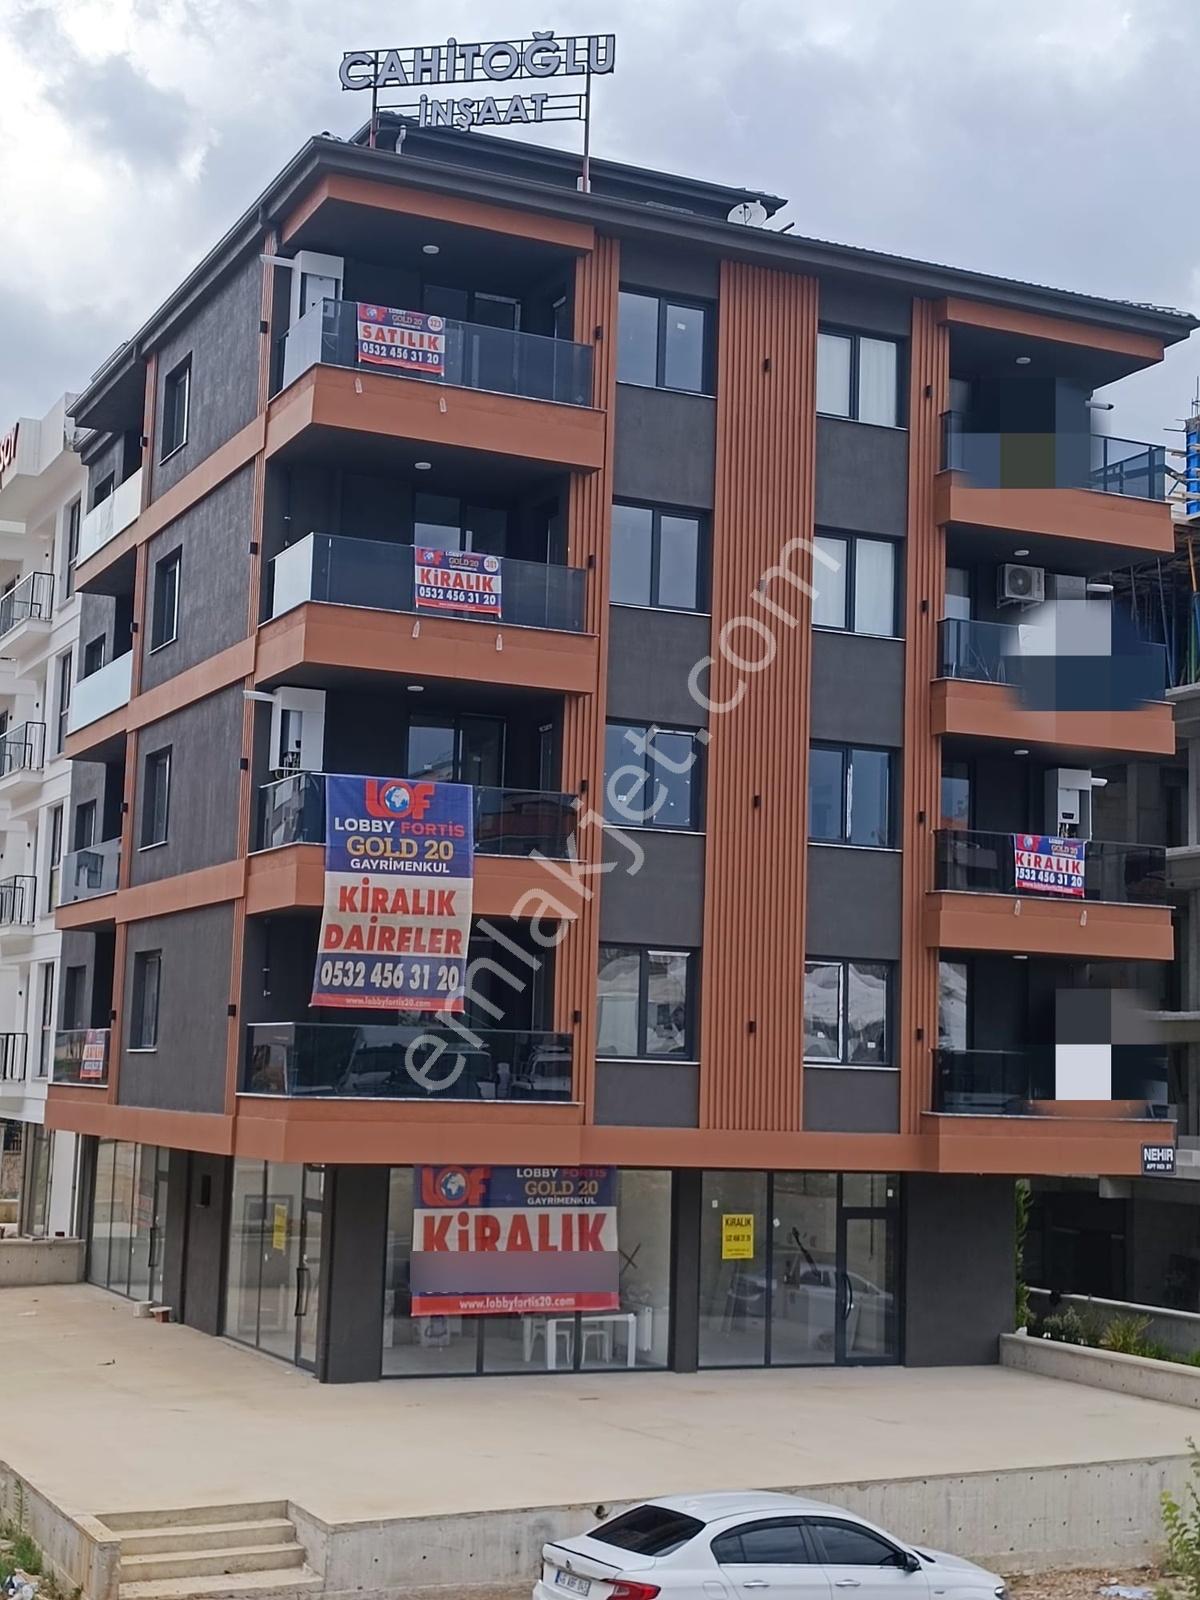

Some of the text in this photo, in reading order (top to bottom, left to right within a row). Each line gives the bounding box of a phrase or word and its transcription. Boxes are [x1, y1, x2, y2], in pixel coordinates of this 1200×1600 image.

[339, 31, 615, 90] CAHİTOĞLU
[419, 94, 548, 131] İNŞAAT
[363, 325, 438, 350] SATILIK
[362, 342, 386, 356] 0532
[390, 347, 408, 359] 456
[411, 351, 422, 362] 31
[427, 354, 439, 364] 20
[419, 586, 496, 605] 0532 456 31 20
[335, 817, 465, 837] LOBBY FORTİS
[347, 836, 454, 860] GOLD 20
[350, 857, 450, 873] GAYRİMENKUL
[1038, 871, 1055, 883] 456
[1057, 874, 1068, 885] 31
[1071, 876, 1083, 887] 20
[339, 877, 456, 916] KİRALIK
[324, 916, 463, 954] DAİRELER
[321, 960, 460, 991] 0532 456 31 20
[516, 1168, 558, 1178] LOBBY
[525, 1180, 598, 1196] GOLD 20
[527, 1195, 597, 1205] GAYRİMENKUL
[460, 1296, 575, 1311] www.lobbyfortis20.com
